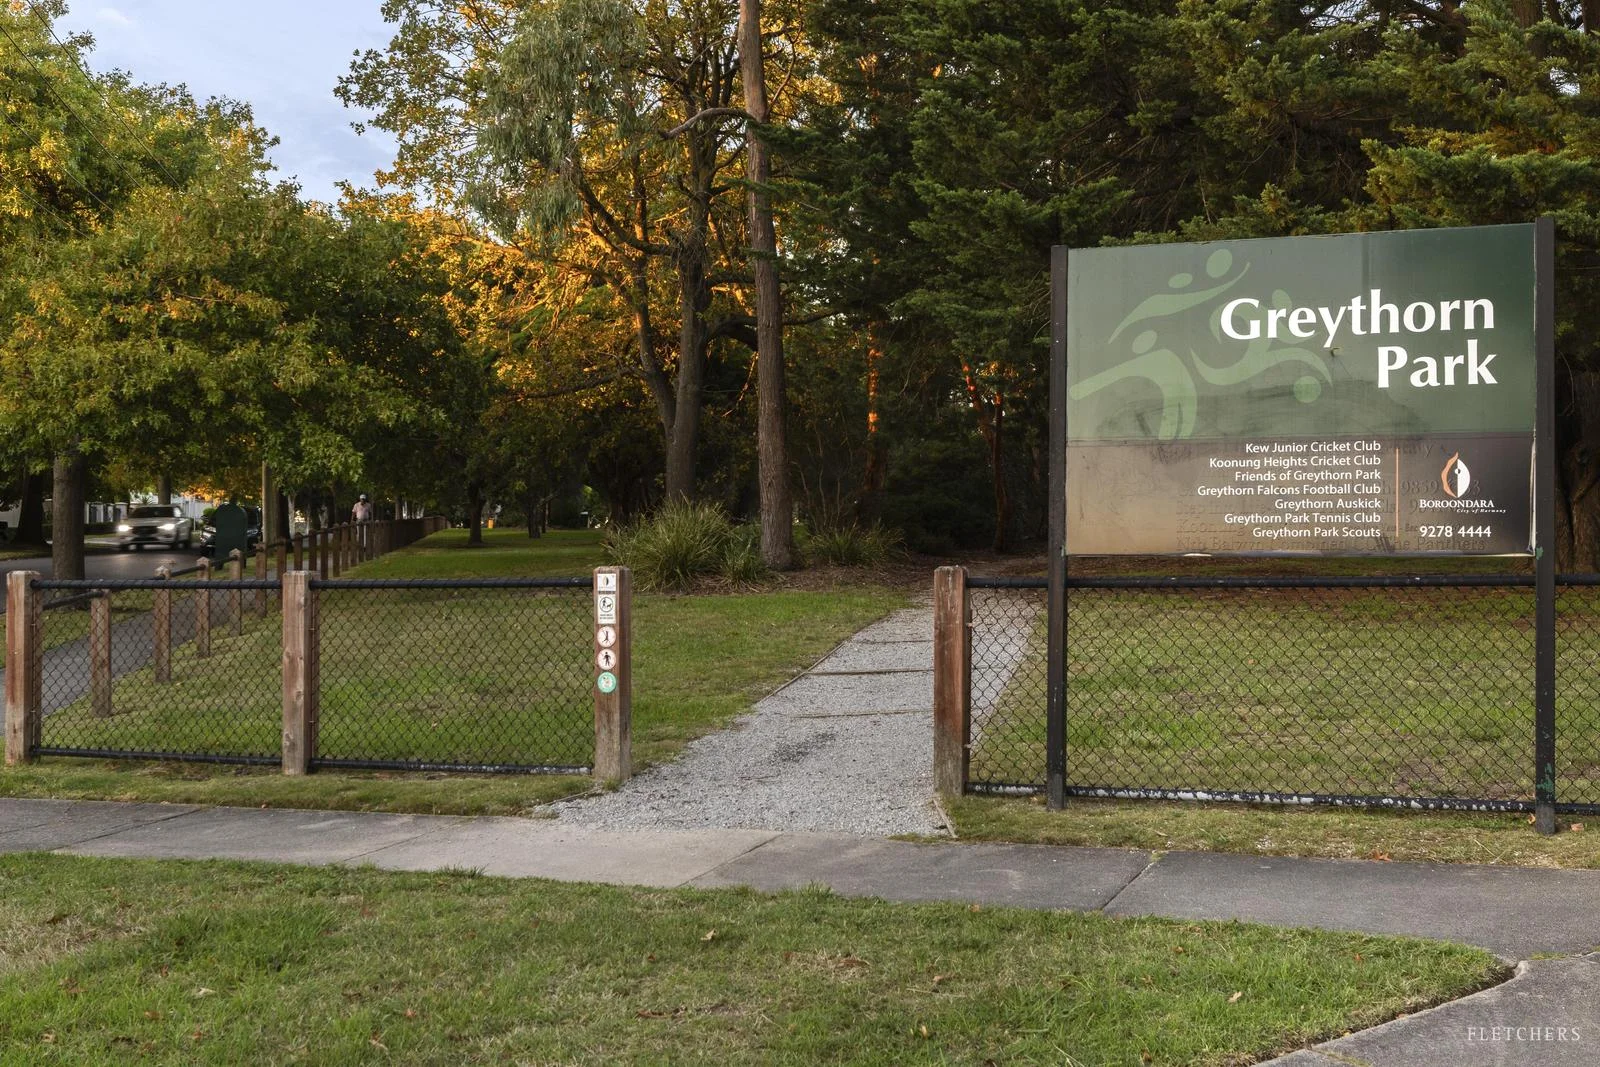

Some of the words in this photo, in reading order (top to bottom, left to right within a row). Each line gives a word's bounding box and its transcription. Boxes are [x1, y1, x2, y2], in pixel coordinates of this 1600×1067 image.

[1221, 289, 1495, 347] Greythorn
[1377, 339, 1497, 388] Park
[1244, 442, 1271, 454] Kew
[1271, 441, 1309, 454] Junior
[1310, 441, 1351, 452] Cricket
[1353, 440, 1381, 452] Club
[1209, 457, 1261, 470] Koonung
[1263, 455, 1308, 470] Heights
[1309, 455, 1352, 467] Cricket
[1353, 454, 1381, 466] Club
[1234, 469, 1277, 482] Friends
[1278, 469, 1292, 481] of
[1293, 469, 1353, 483] Greythorn
[1355, 468, 1382, 480] Park
[1197, 484, 1255, 499] Greythorn
[1257, 484, 1301, 496] Falcons
[1303, 483, 1351, 495] Football
[1353, 483, 1382, 495] Club
[1274, 498, 1334, 512] Greythorn
[1336, 497, 1382, 509] Auskick
[1419, 499, 1495, 508] BOROONDARA
[1224, 512, 1282, 526] Greythorn
[1284, 512, 1310, 524] Park
[1311, 512, 1351, 523] Tennis
[1353, 511, 1381, 523] Club
[1252, 526, 1311, 540] Greythorn
[1314, 526, 1340, 537] Park
[1341, 526, 1381, 538] Scouts
[1420, 526, 1452, 537] 9278
[1458, 526, 1491, 537] 4444
